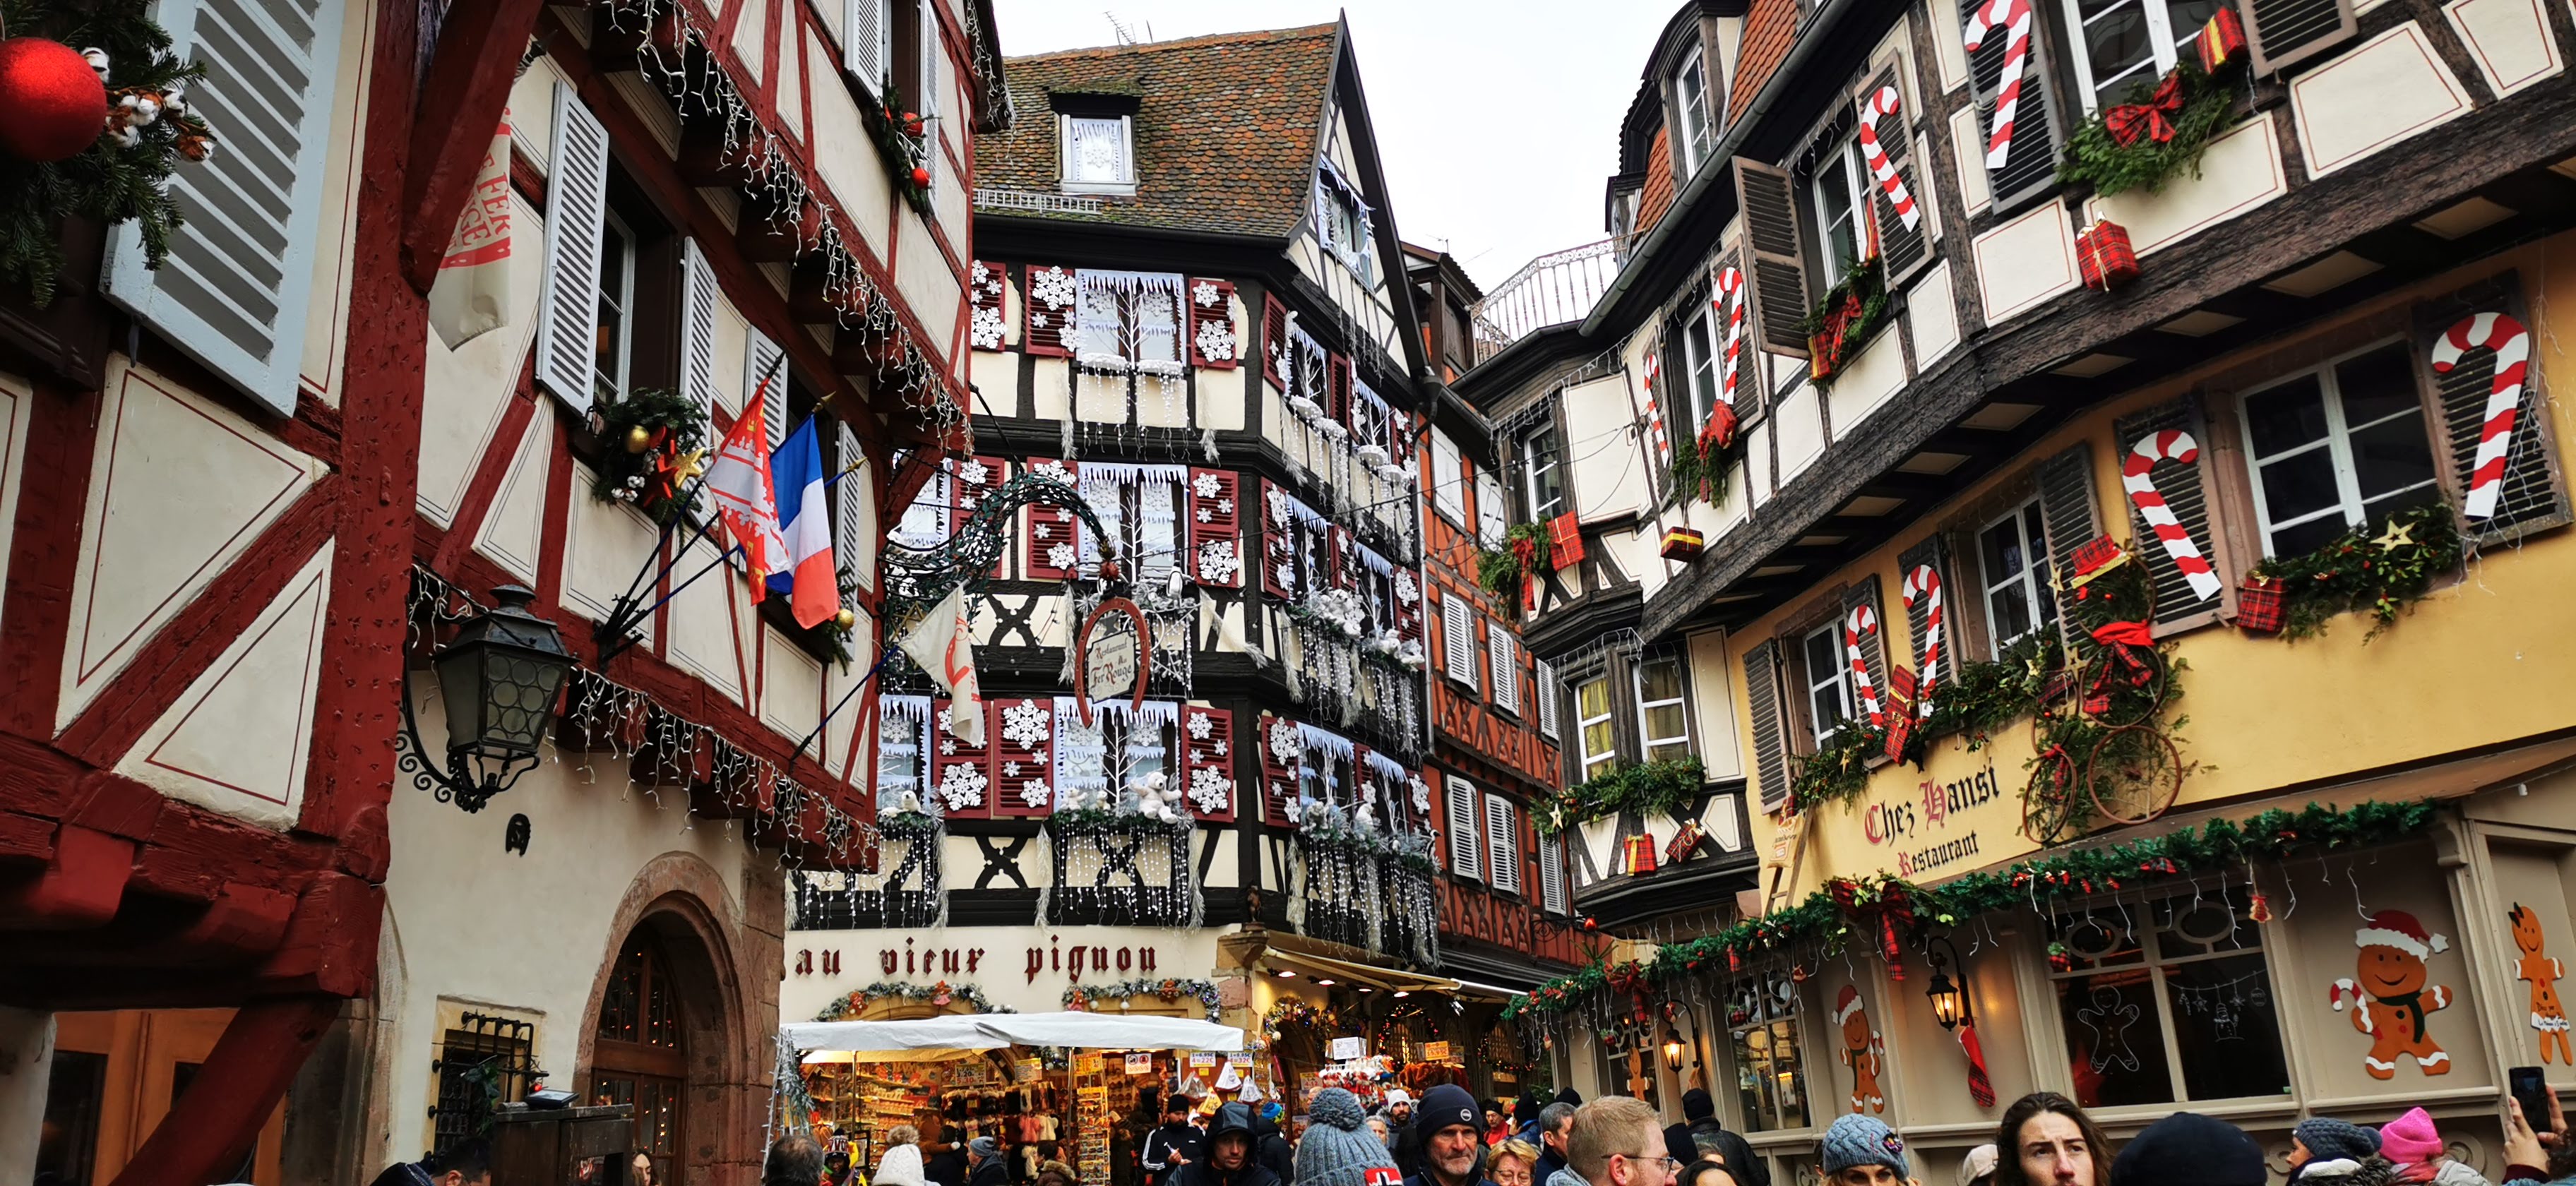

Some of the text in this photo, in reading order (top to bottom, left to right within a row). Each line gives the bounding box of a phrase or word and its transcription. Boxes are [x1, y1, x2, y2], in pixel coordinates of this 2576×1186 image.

[1090, 661, 1132, 689] Fer Rouge
[1864, 756, 2000, 847] Chez Hansi
[1897, 829, 1979, 877] Restaurant
[794, 934, 1157, 986] au vieux pignon
